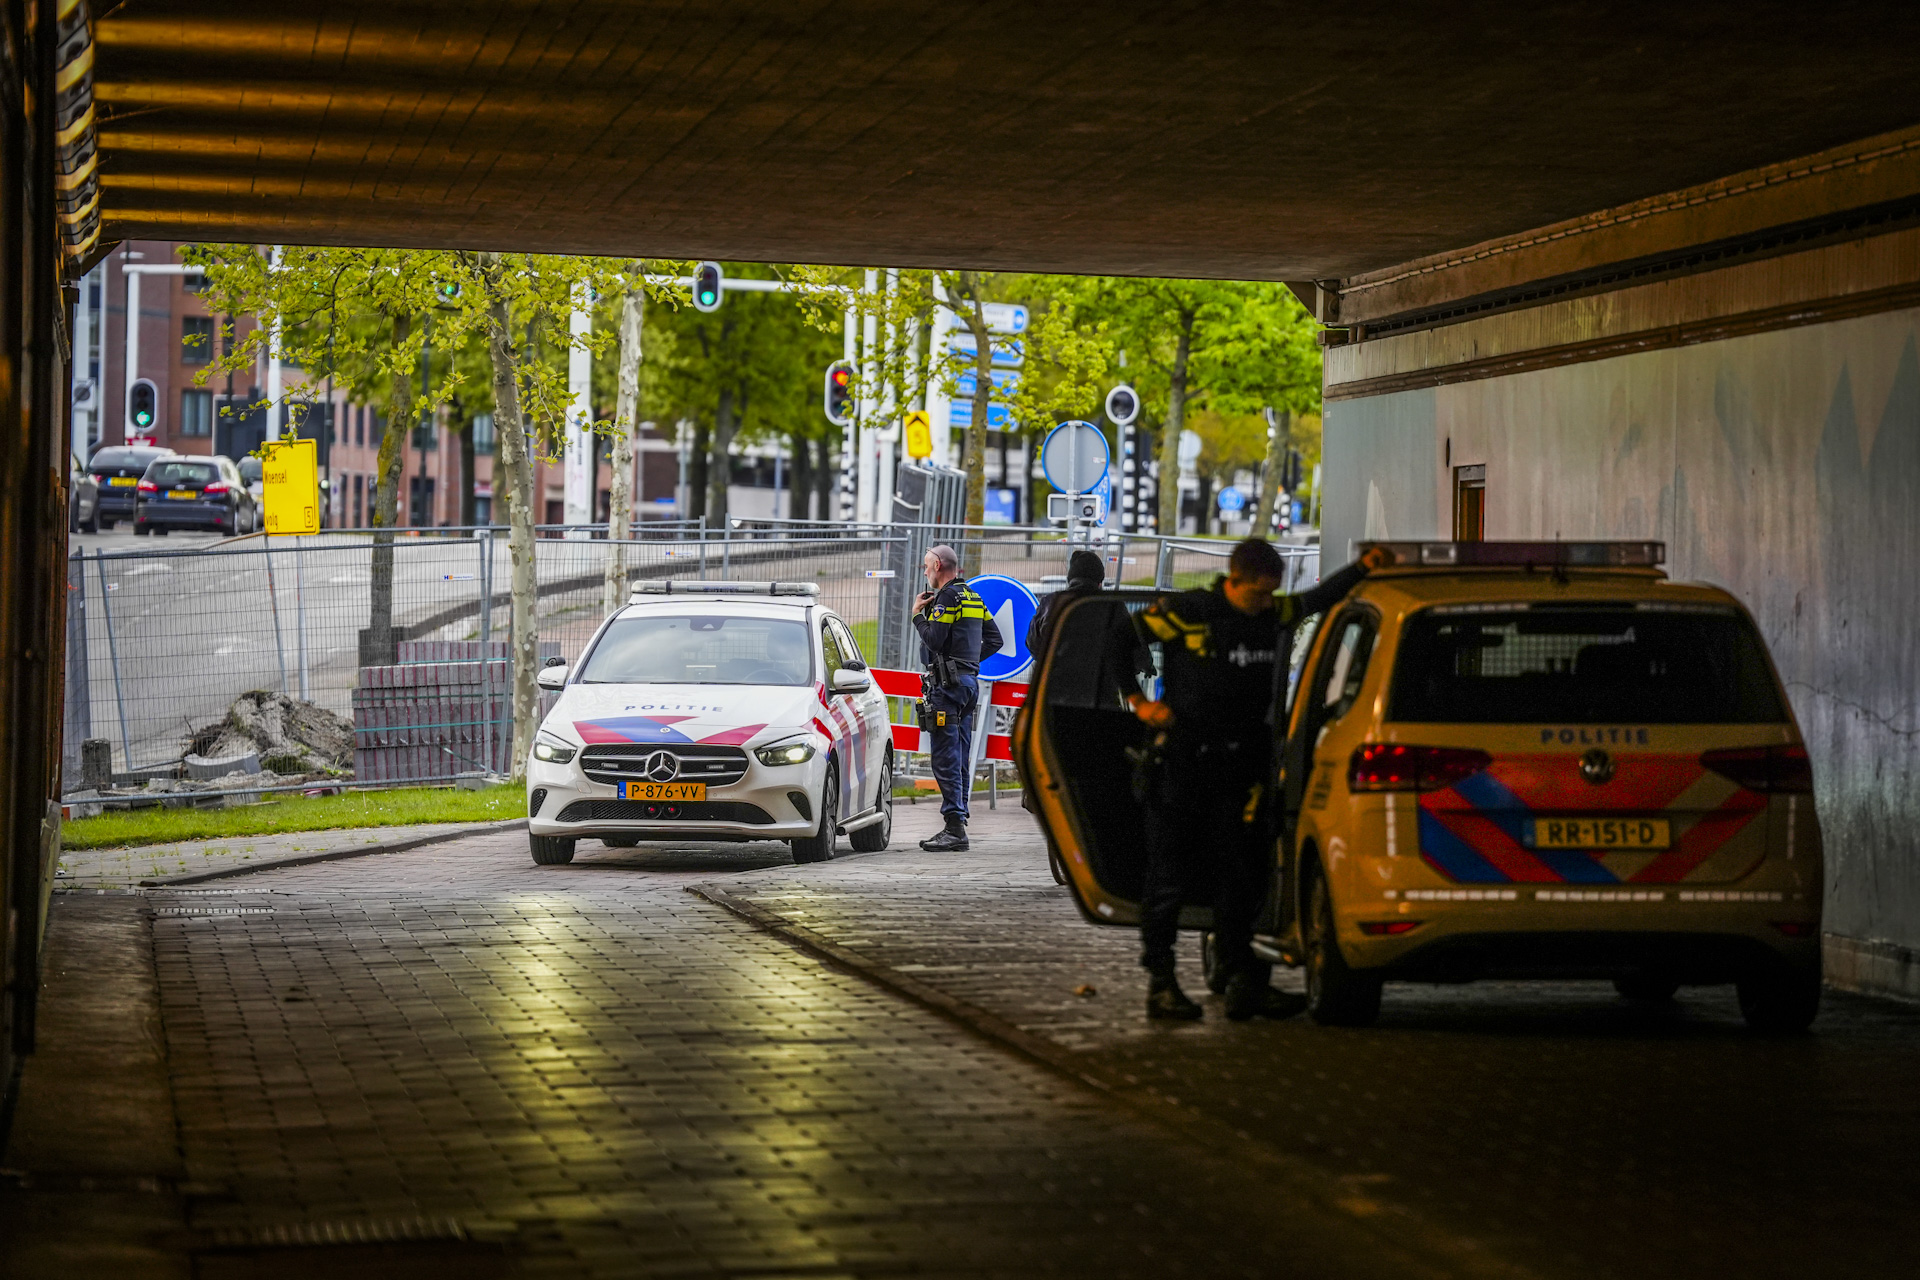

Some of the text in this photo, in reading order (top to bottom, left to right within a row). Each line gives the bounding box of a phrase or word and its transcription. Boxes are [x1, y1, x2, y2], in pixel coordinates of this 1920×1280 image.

[1540, 728, 1649, 745] POLITIE
[631, 784, 699, 798] P-876-VV
[1548, 821, 1655, 844] RR-151-D
